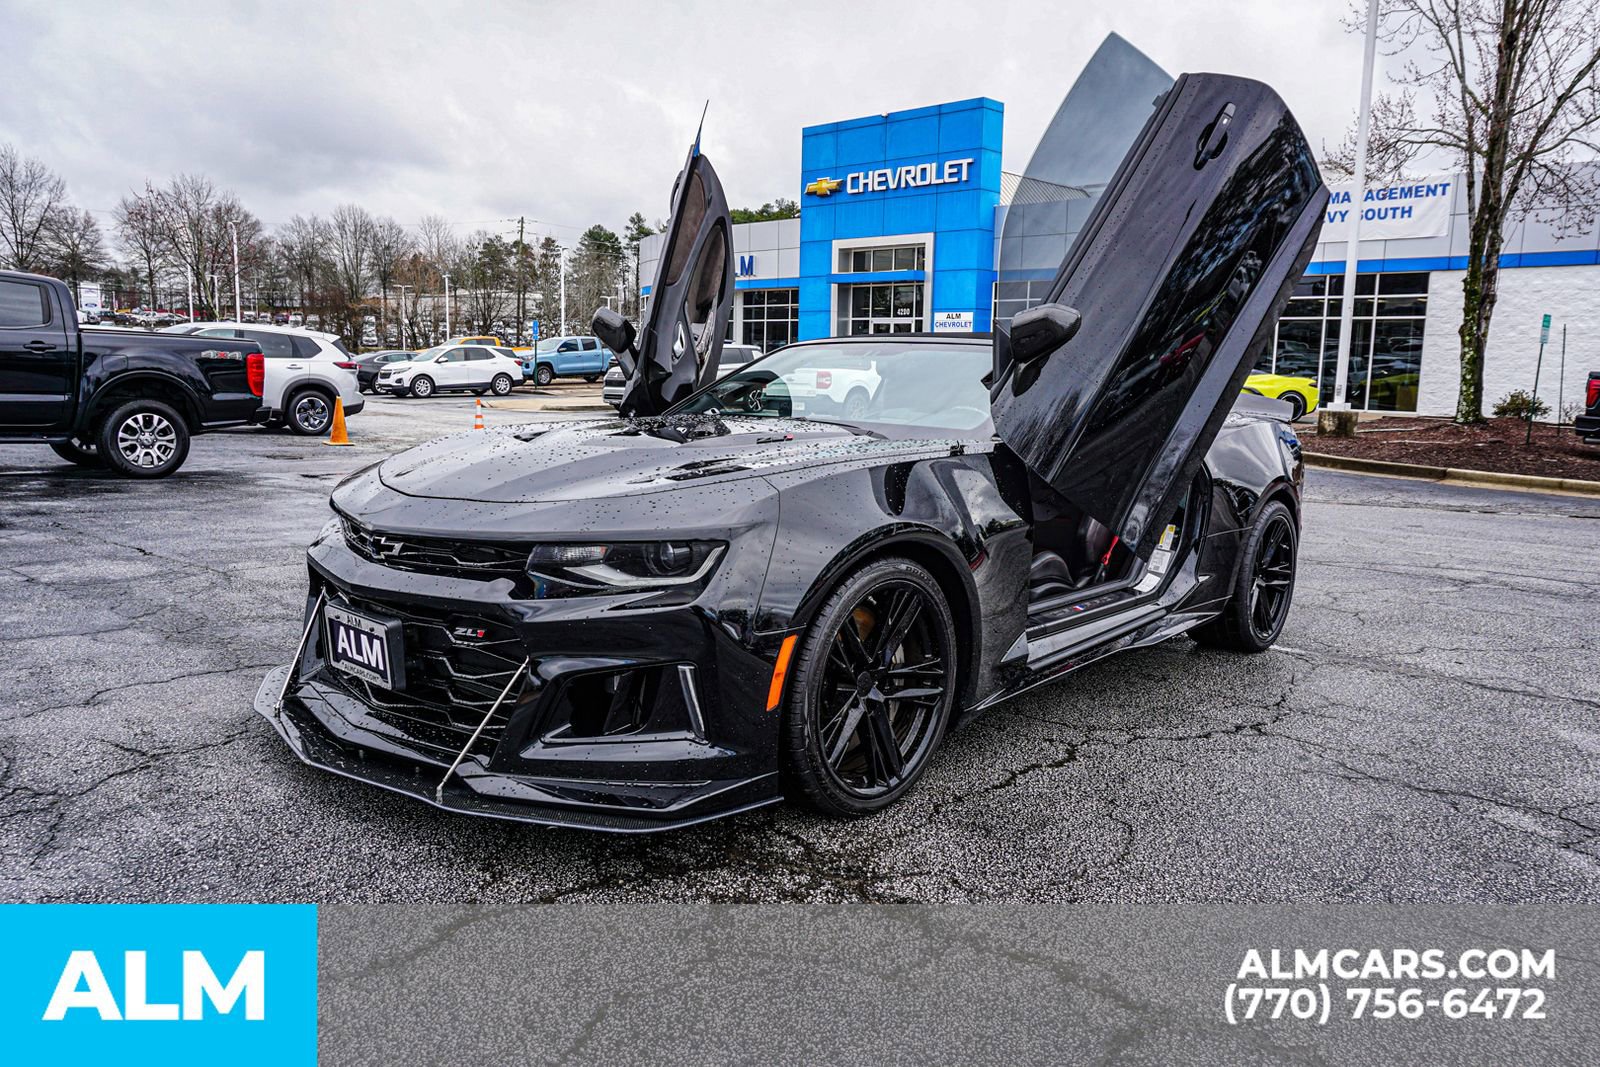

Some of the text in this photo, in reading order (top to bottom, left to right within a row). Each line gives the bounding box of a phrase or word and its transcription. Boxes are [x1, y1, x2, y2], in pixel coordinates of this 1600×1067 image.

[846, 158, 974, 194] CHEVROLET
[1329, 183, 1450, 204] MAAGEMENT
[453, 627, 485, 638] ZL1
[337, 625, 384, 671] ALM
